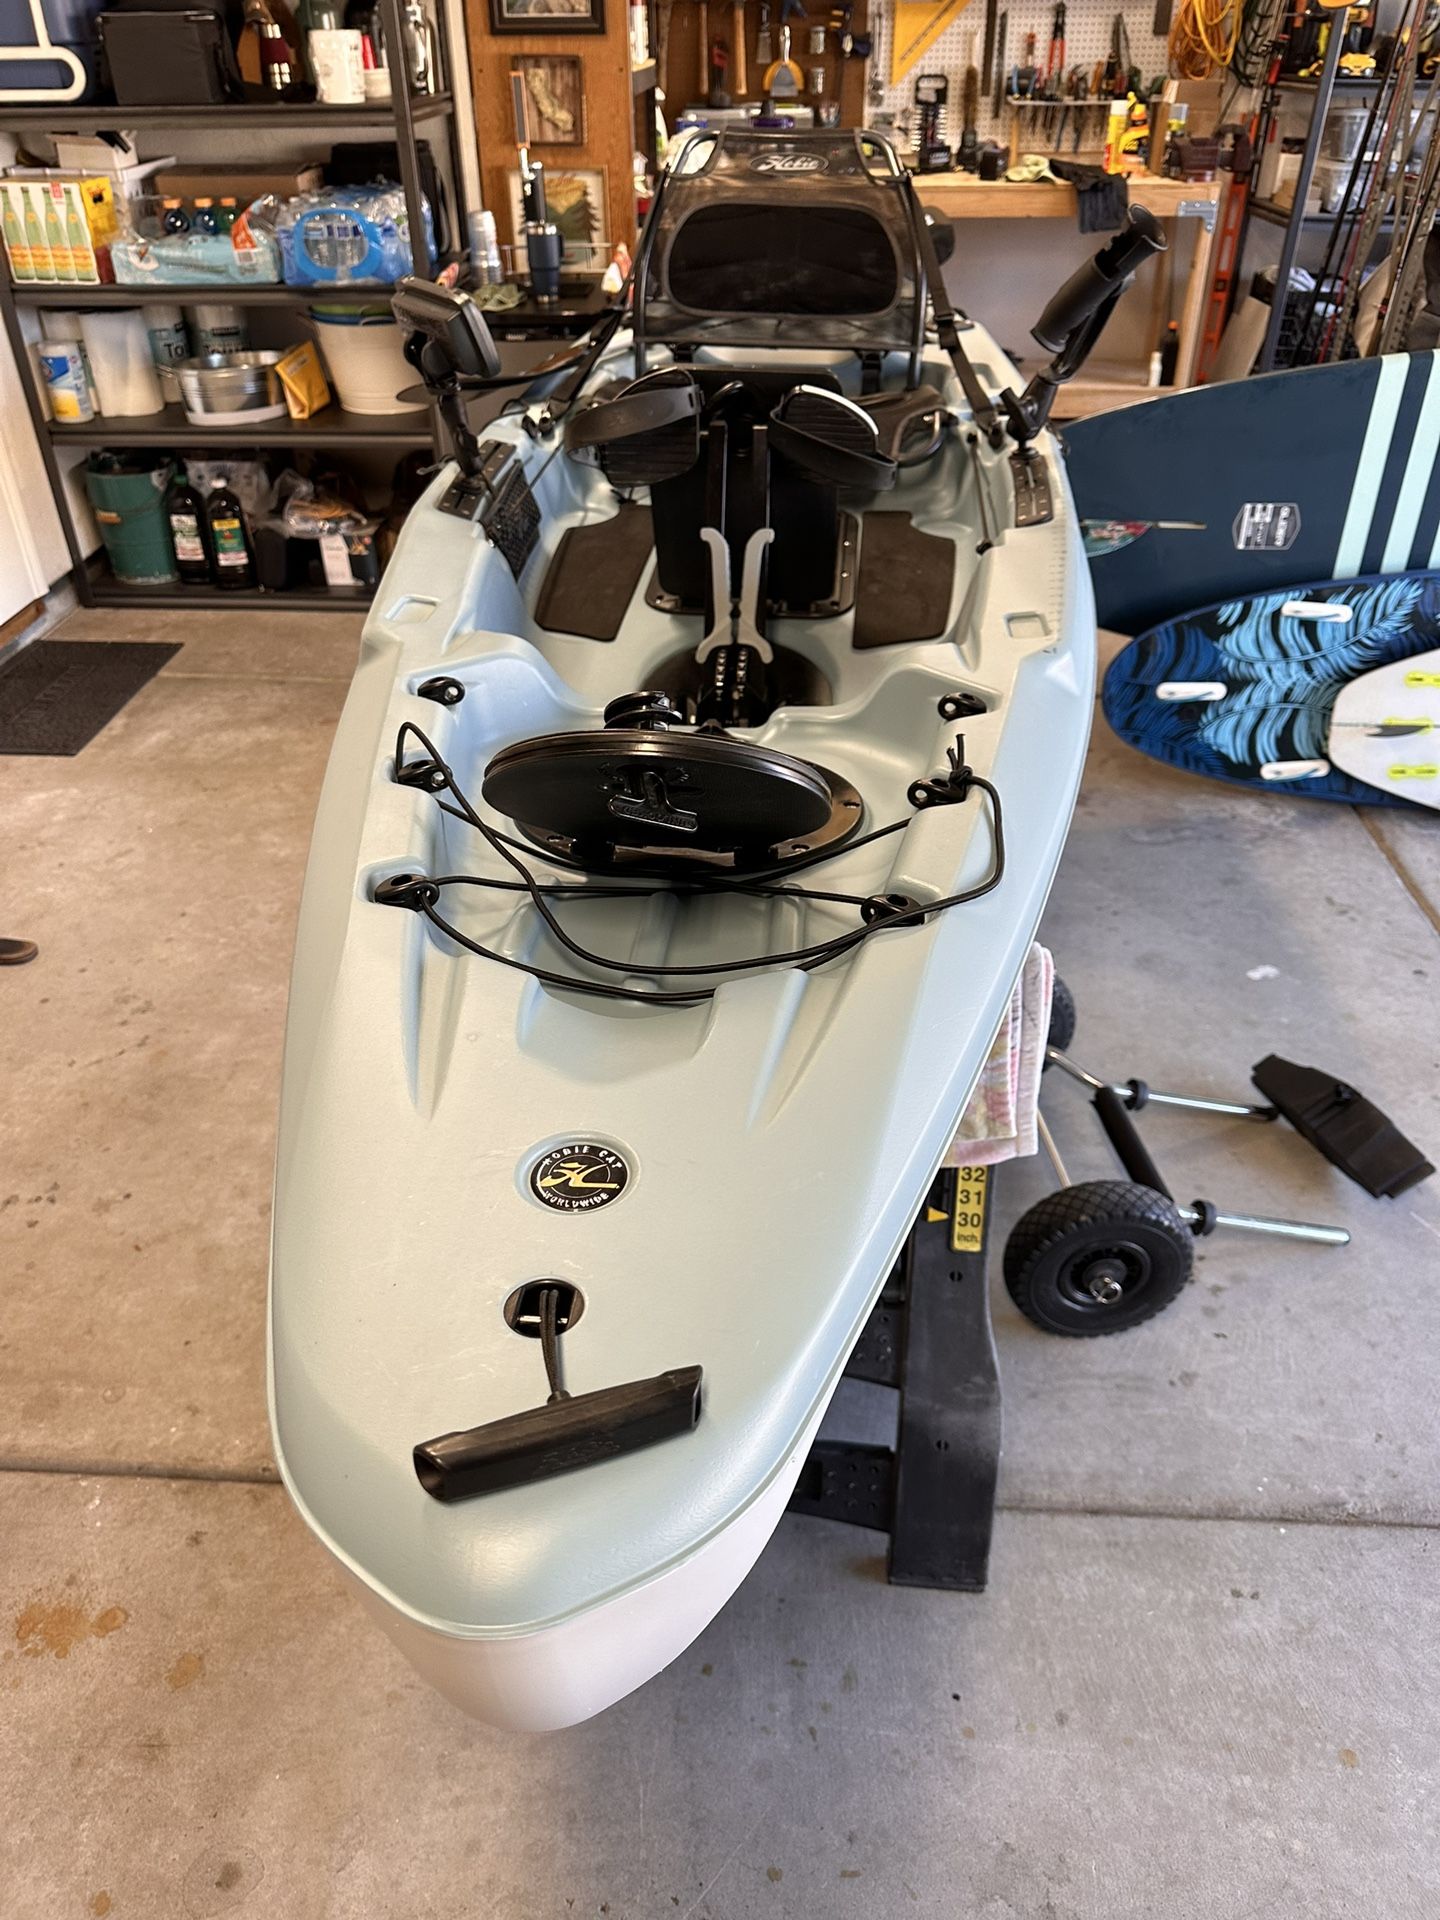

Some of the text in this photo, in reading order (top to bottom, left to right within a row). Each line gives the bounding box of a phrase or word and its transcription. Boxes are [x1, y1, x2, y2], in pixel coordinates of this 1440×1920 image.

[598, 1150, 623, 1169] CAT
[961, 1166, 985, 1183] 32
[960, 1189, 982, 1205] 31
[957, 1211, 981, 1228] 30
